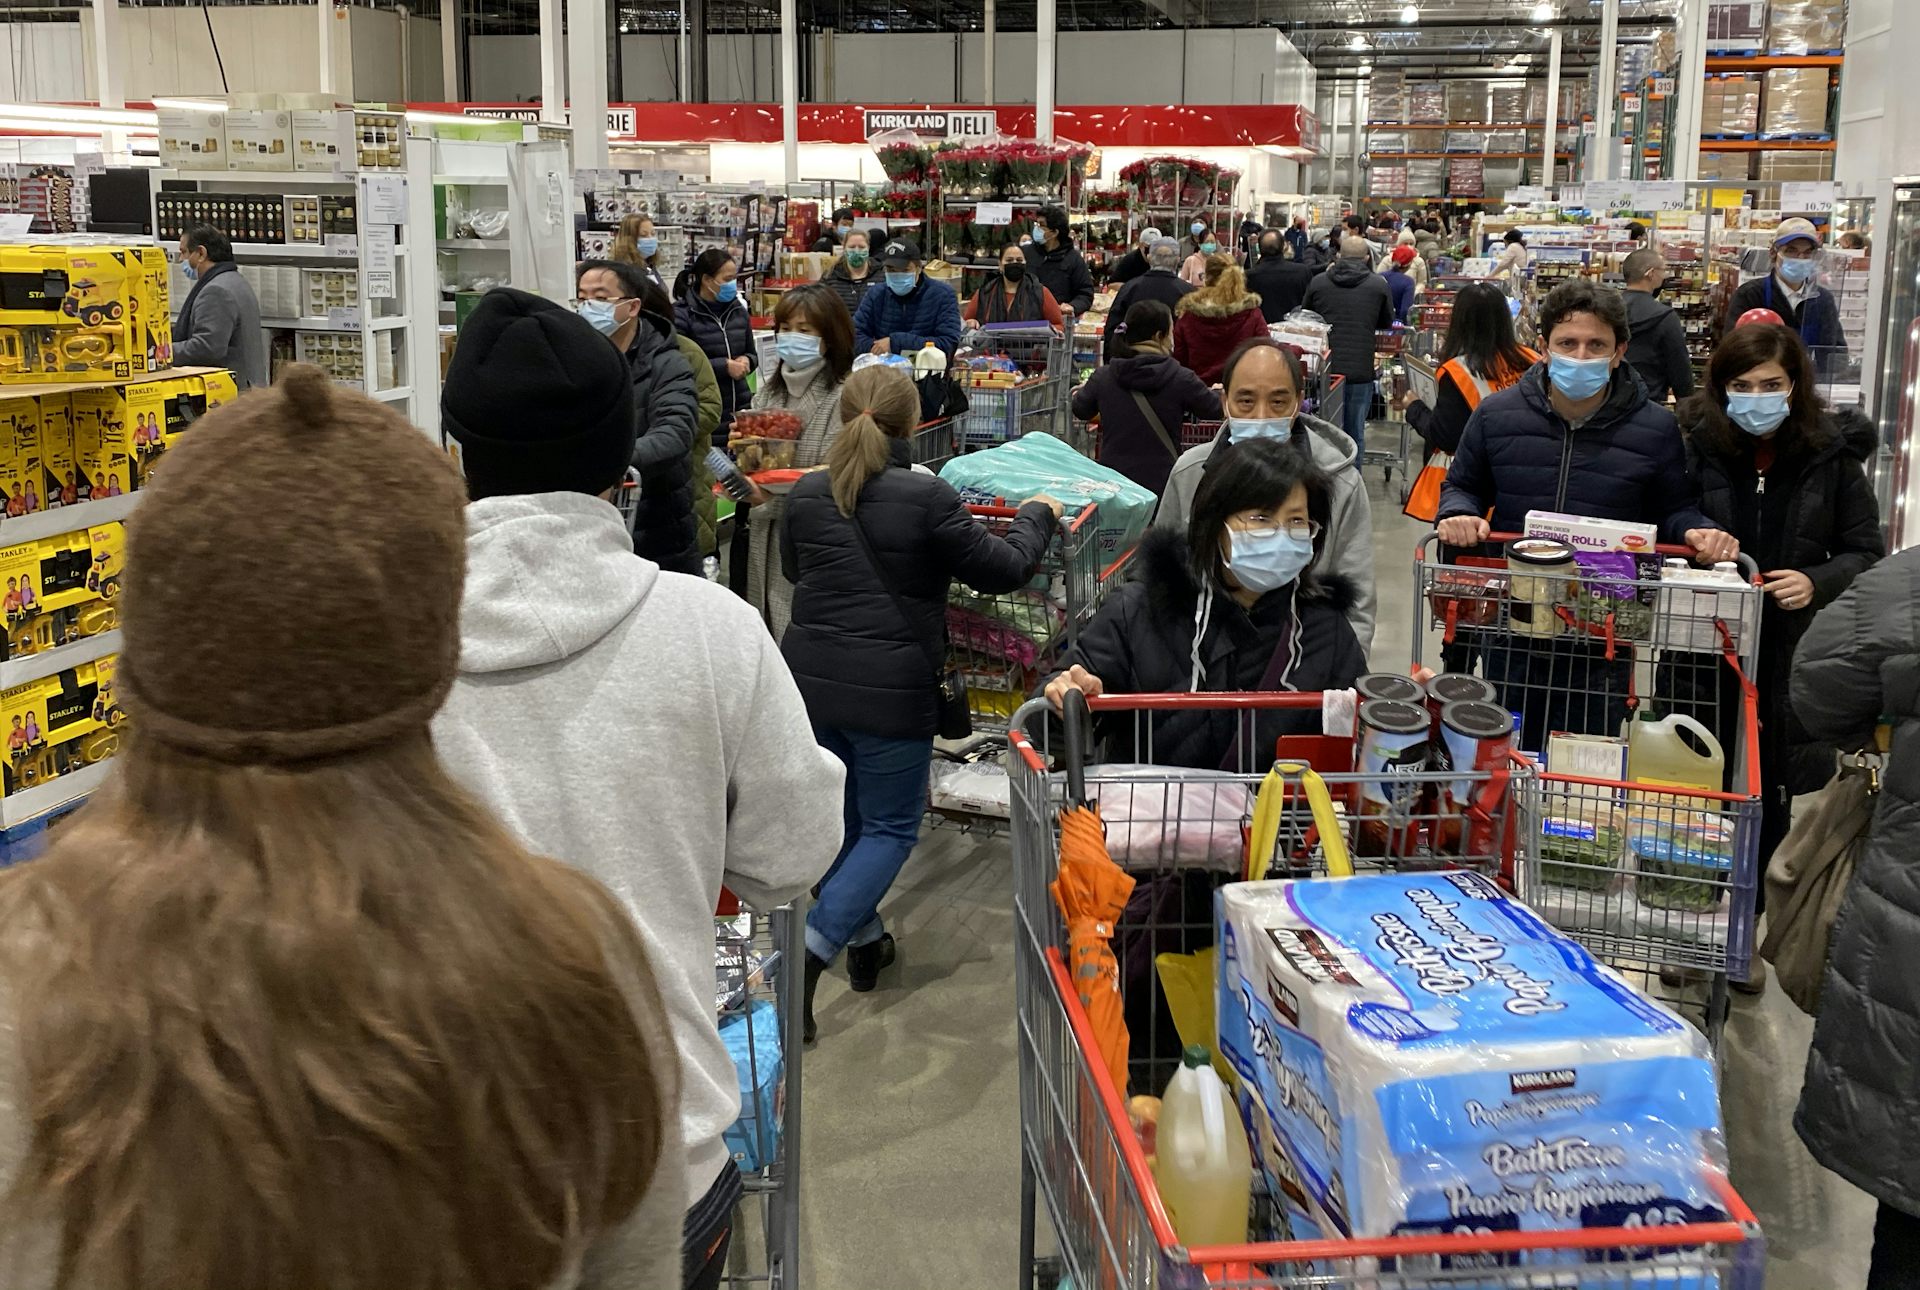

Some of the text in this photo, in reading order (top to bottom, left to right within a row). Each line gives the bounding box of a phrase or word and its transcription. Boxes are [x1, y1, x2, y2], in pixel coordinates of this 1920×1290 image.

[1657, 82, 1672, 91] 313
[1626, 101, 1639, 109] 315
[469, 111, 537, 121] KLAND
[871, 115, 987, 135] KIRKLAND DELI
[1610, 200, 1631, 209] 6.99
[1662, 201, 1683, 210] 7.99
[1804, 203, 1832, 211] 10.79
[116, 363, 128, 371] 46
[128, 386, 154, 396] STANLEY
[1528, 529, 1608, 547] SPRING ROLLS
[0, 546, 28, 558] TANLEY
[0, 684, 33, 699] STANLEY
[49, 705, 79, 720] STANLEY
[1513, 1070, 1576, 1089] KIRKLAND
[1465, 1099, 1517, 1130] Papier
[1483, 1135, 1626, 1177] Bath Tissue
[1444, 1182, 1529, 1218] Papier
